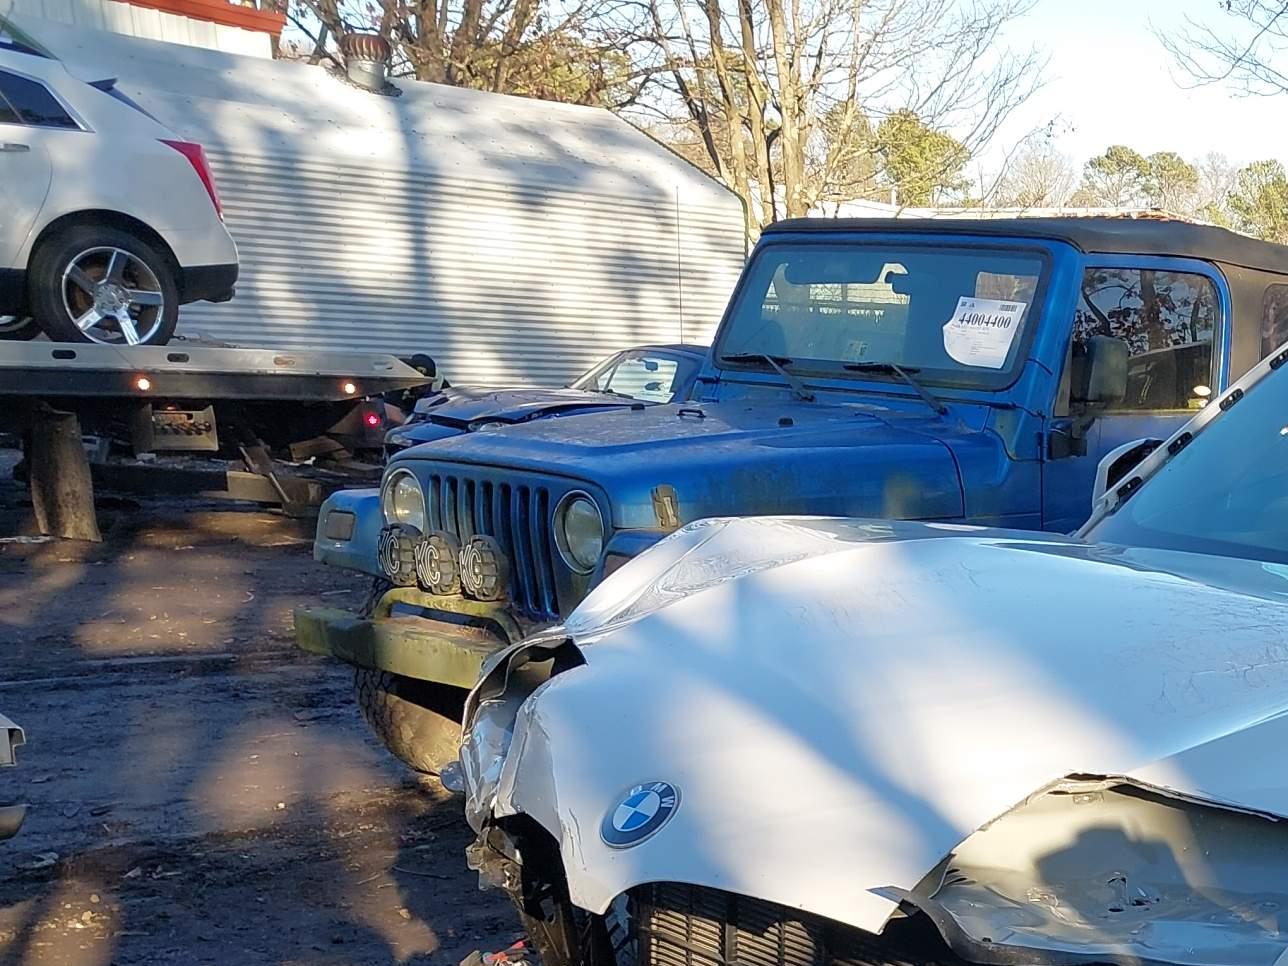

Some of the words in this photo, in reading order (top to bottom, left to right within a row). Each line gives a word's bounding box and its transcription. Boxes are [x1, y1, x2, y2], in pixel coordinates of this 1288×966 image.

[958, 312, 1012, 329] 44004400
[414, 541, 440, 588] KC
[459, 545, 483, 595] KC
[630, 783, 675, 808] BMW
